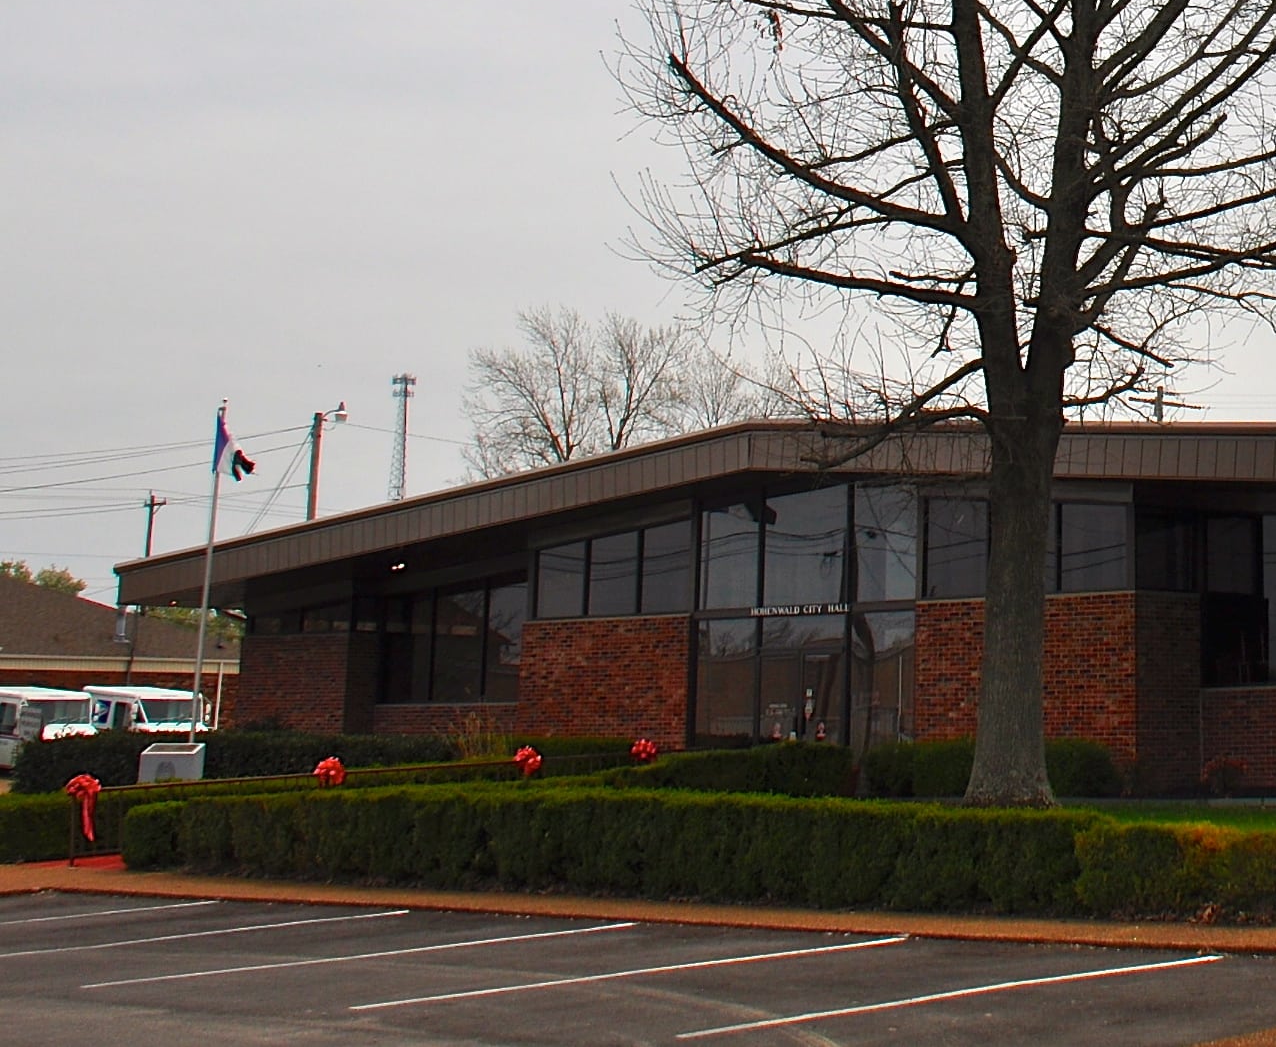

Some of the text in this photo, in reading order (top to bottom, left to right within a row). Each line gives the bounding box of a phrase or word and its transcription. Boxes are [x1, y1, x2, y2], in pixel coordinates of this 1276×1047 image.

[750, 603, 850, 616] HOHENWALD CITY HALL
